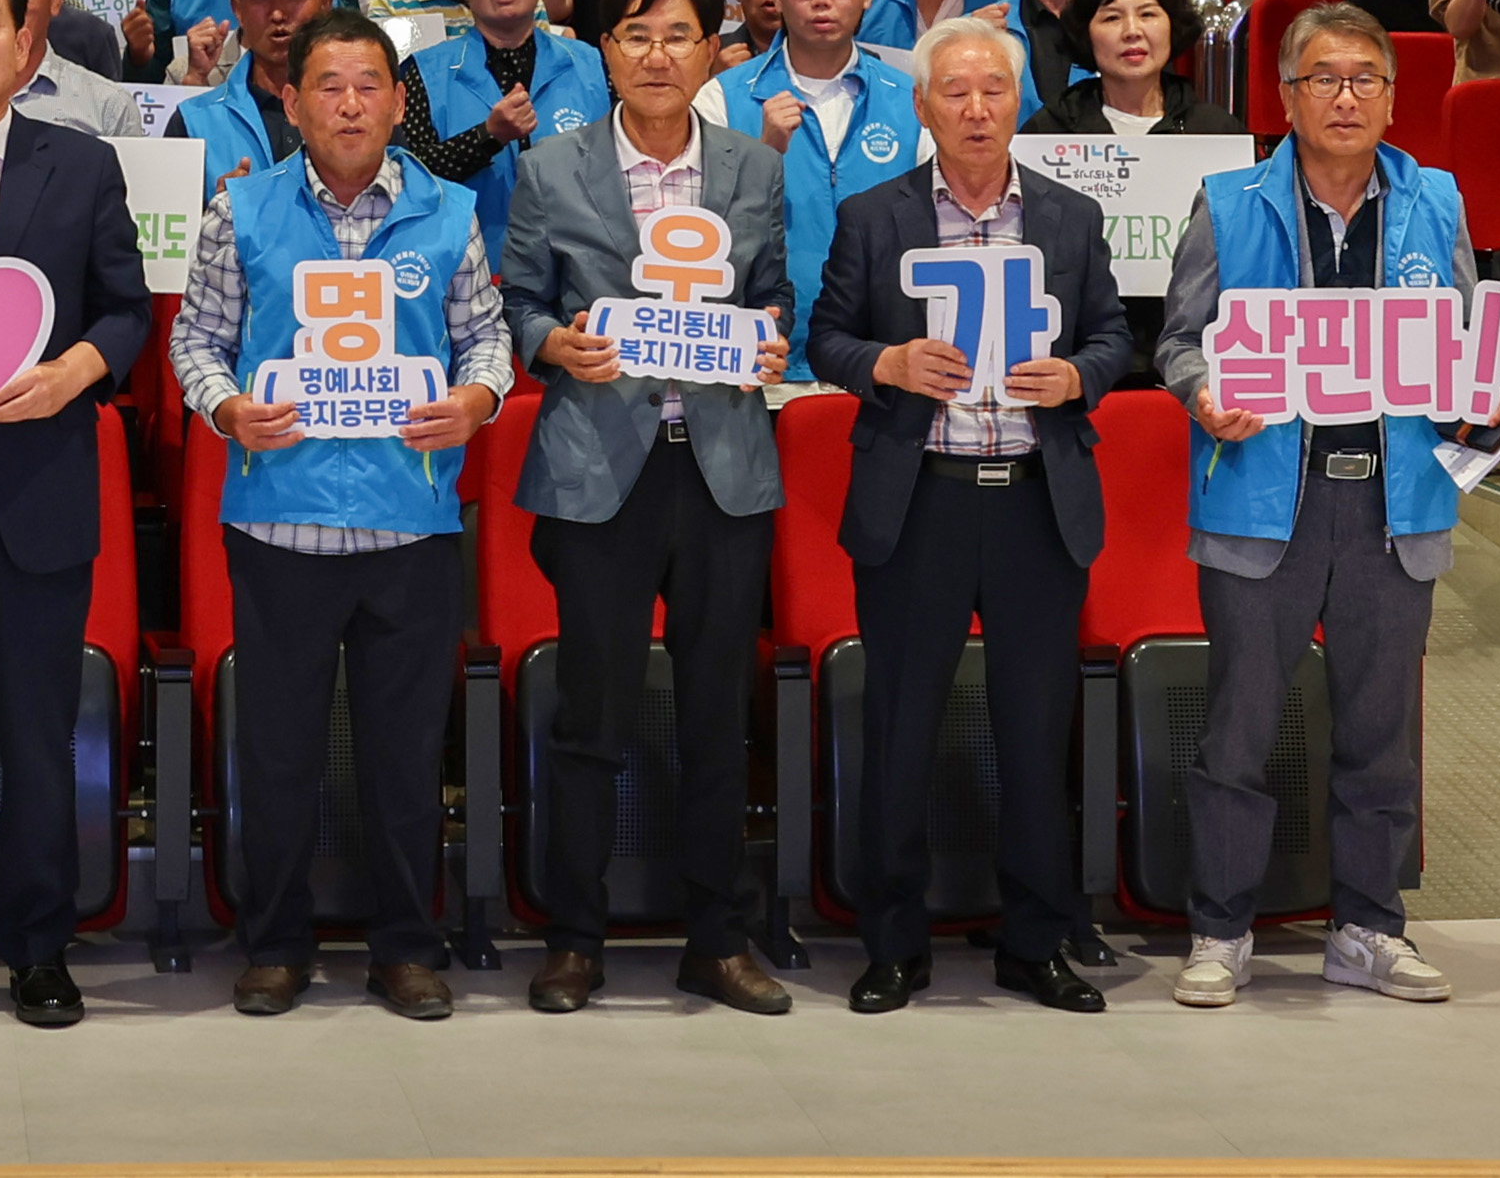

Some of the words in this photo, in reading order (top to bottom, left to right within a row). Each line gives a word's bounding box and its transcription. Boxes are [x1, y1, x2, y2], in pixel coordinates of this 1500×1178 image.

[642, 215, 724, 302] 우
[304, 271, 383, 362] 명
[618, 338, 742, 373] 복지기동대
[633, 307, 732, 340] 우리동네
[912, 259, 1048, 393] 가
